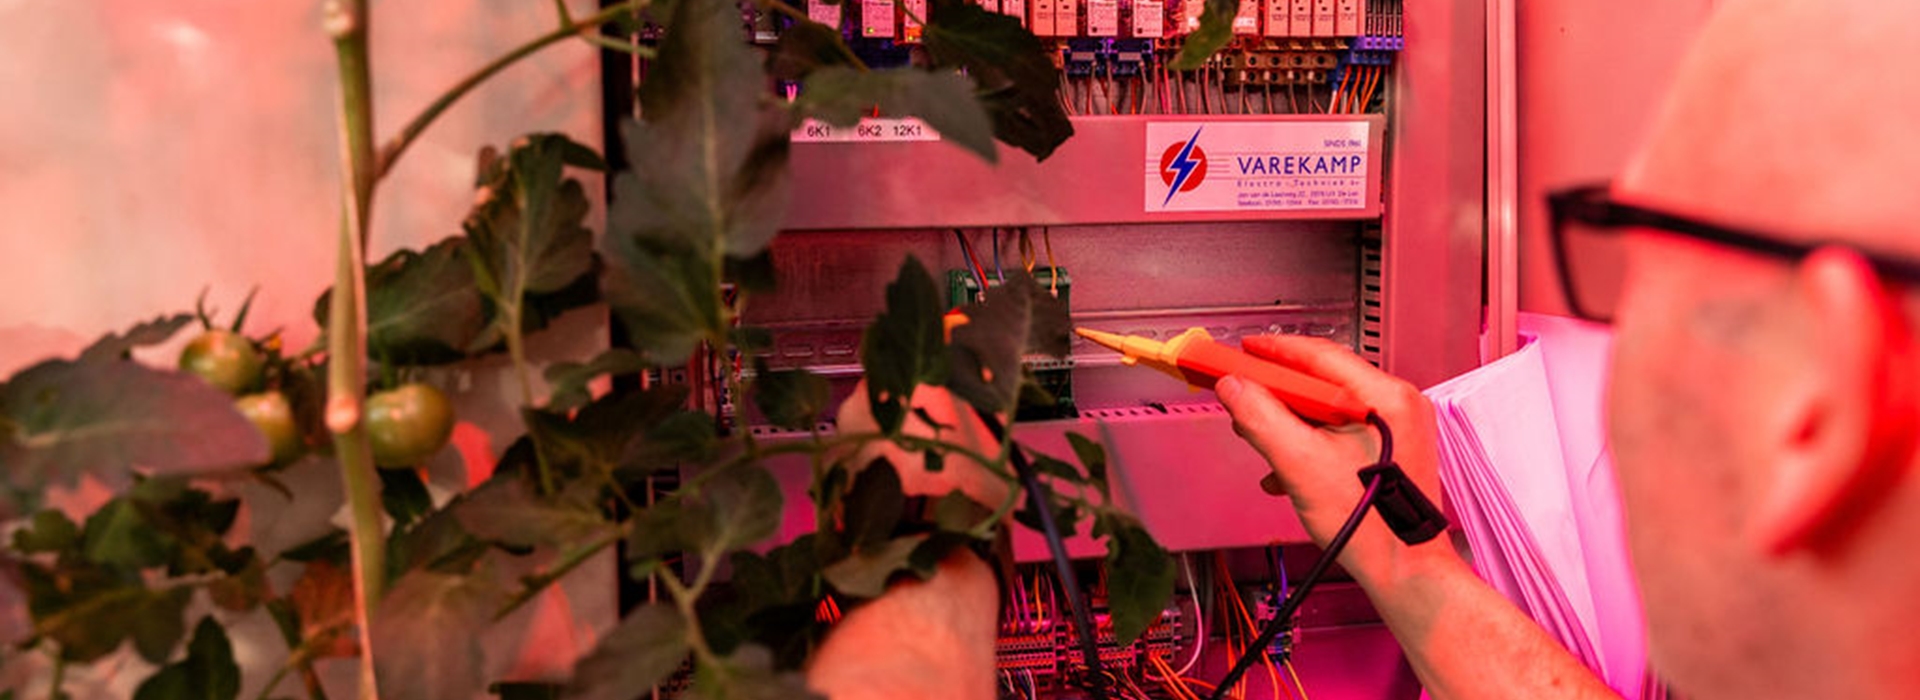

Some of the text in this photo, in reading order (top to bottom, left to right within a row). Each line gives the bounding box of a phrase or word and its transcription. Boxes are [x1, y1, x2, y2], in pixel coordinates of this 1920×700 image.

[807, 125, 831, 137] 6K1
[858, 125, 882, 137] 6K2
[893, 125, 922, 137] 12K1
[1237, 155, 1361, 175] VAREKAMP
